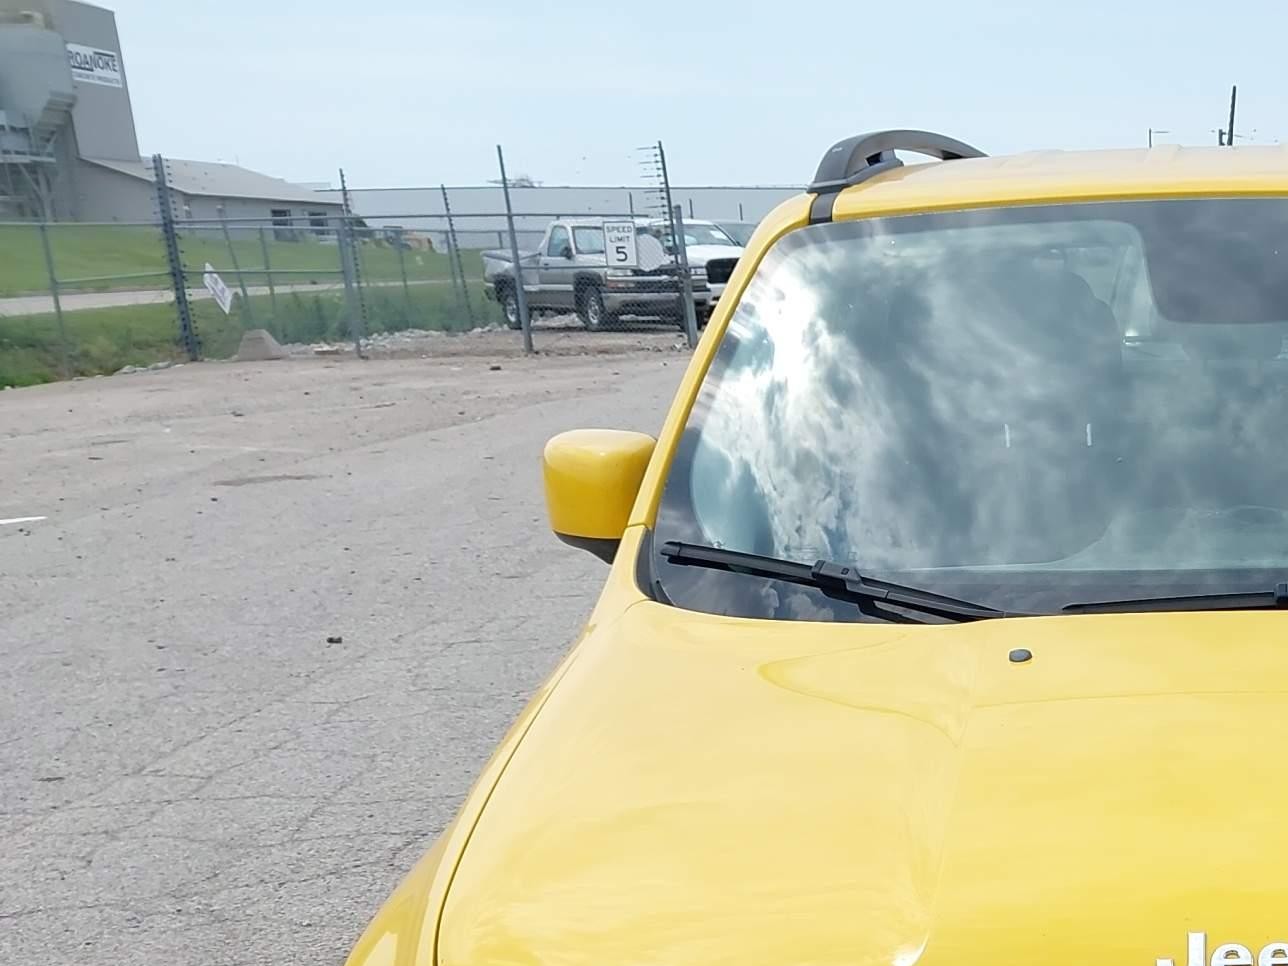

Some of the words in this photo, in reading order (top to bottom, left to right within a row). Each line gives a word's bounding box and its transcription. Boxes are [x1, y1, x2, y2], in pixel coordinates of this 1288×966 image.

[606, 225, 633, 234] SPEED
[609, 235, 630, 243] LIMIT
[615, 246, 628, 262] 5
